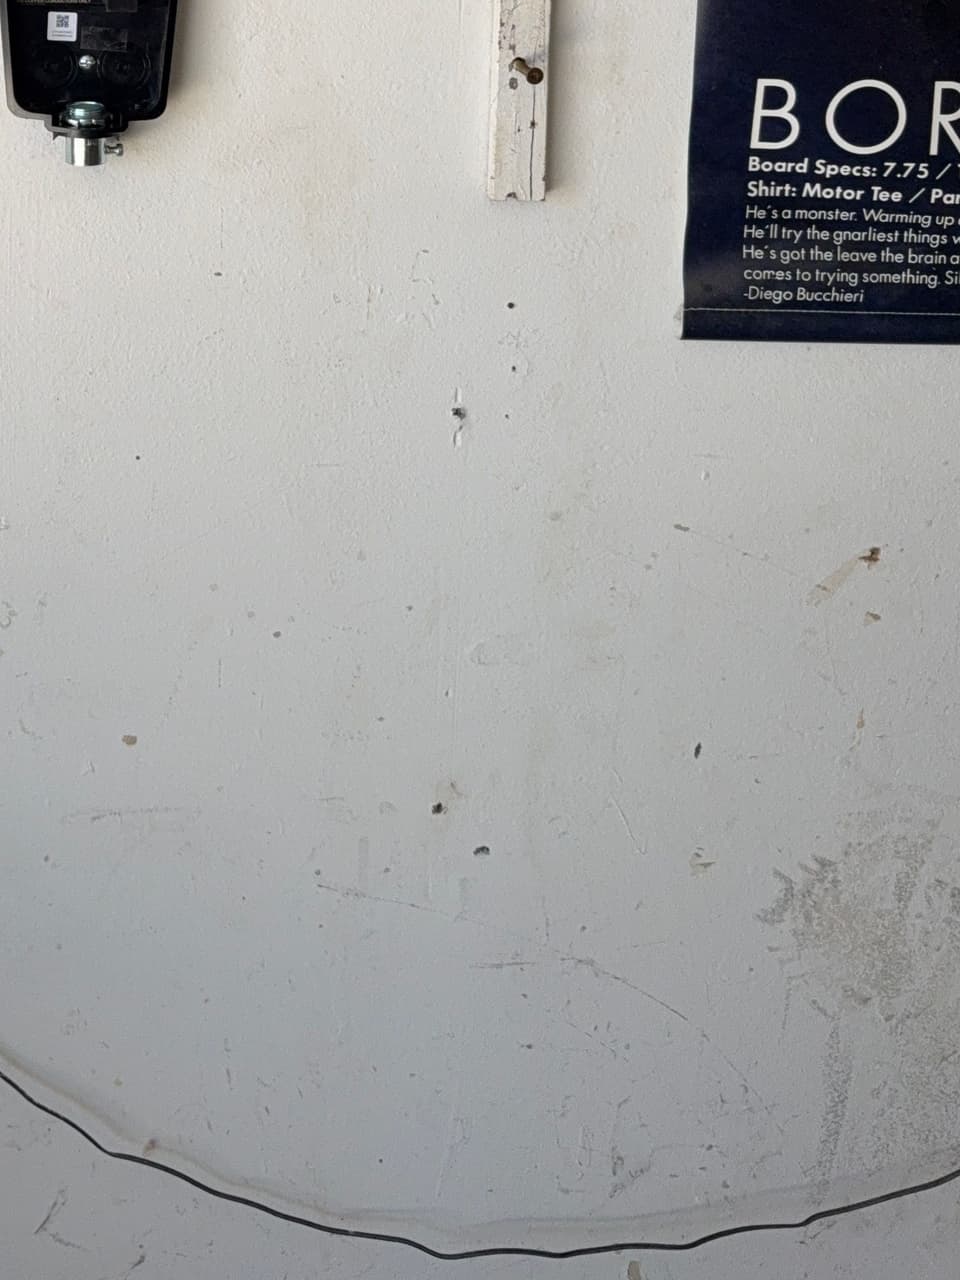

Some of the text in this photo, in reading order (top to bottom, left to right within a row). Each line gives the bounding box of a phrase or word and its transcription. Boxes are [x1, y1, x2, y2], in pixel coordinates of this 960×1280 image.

[748, 156, 809, 173] Board
[814, 159, 877, 178] Specs:
[883, 162, 929, 179] 7.75
[747, 180, 797, 197] Shirt:
[802, 182, 865, 200] Motor
[871, 186, 903, 202] Tee
[781, 209, 791, 219] a
[795, 208, 857, 221] monster.
[863, 208, 932, 228] Warming
[935, 215, 955, 229] up
[781, 226, 803, 244] try
[807, 224, 830, 240] the
[833, 226, 899, 245] gnarliest
[903, 228, 948, 248] things
[780, 247, 806, 264] got
[809, 245, 833, 261] the
[837, 245, 877, 262] leave
[881, 247, 904, 263] the
[908, 248, 947, 265] brain
[743, 269, 793, 280] comes
[796, 268, 812, 281] to
[815, 269, 858, 287] trying
[862, 268, 941, 289] something.
[743, 285, 864, 304] -Diego Bucchieri
